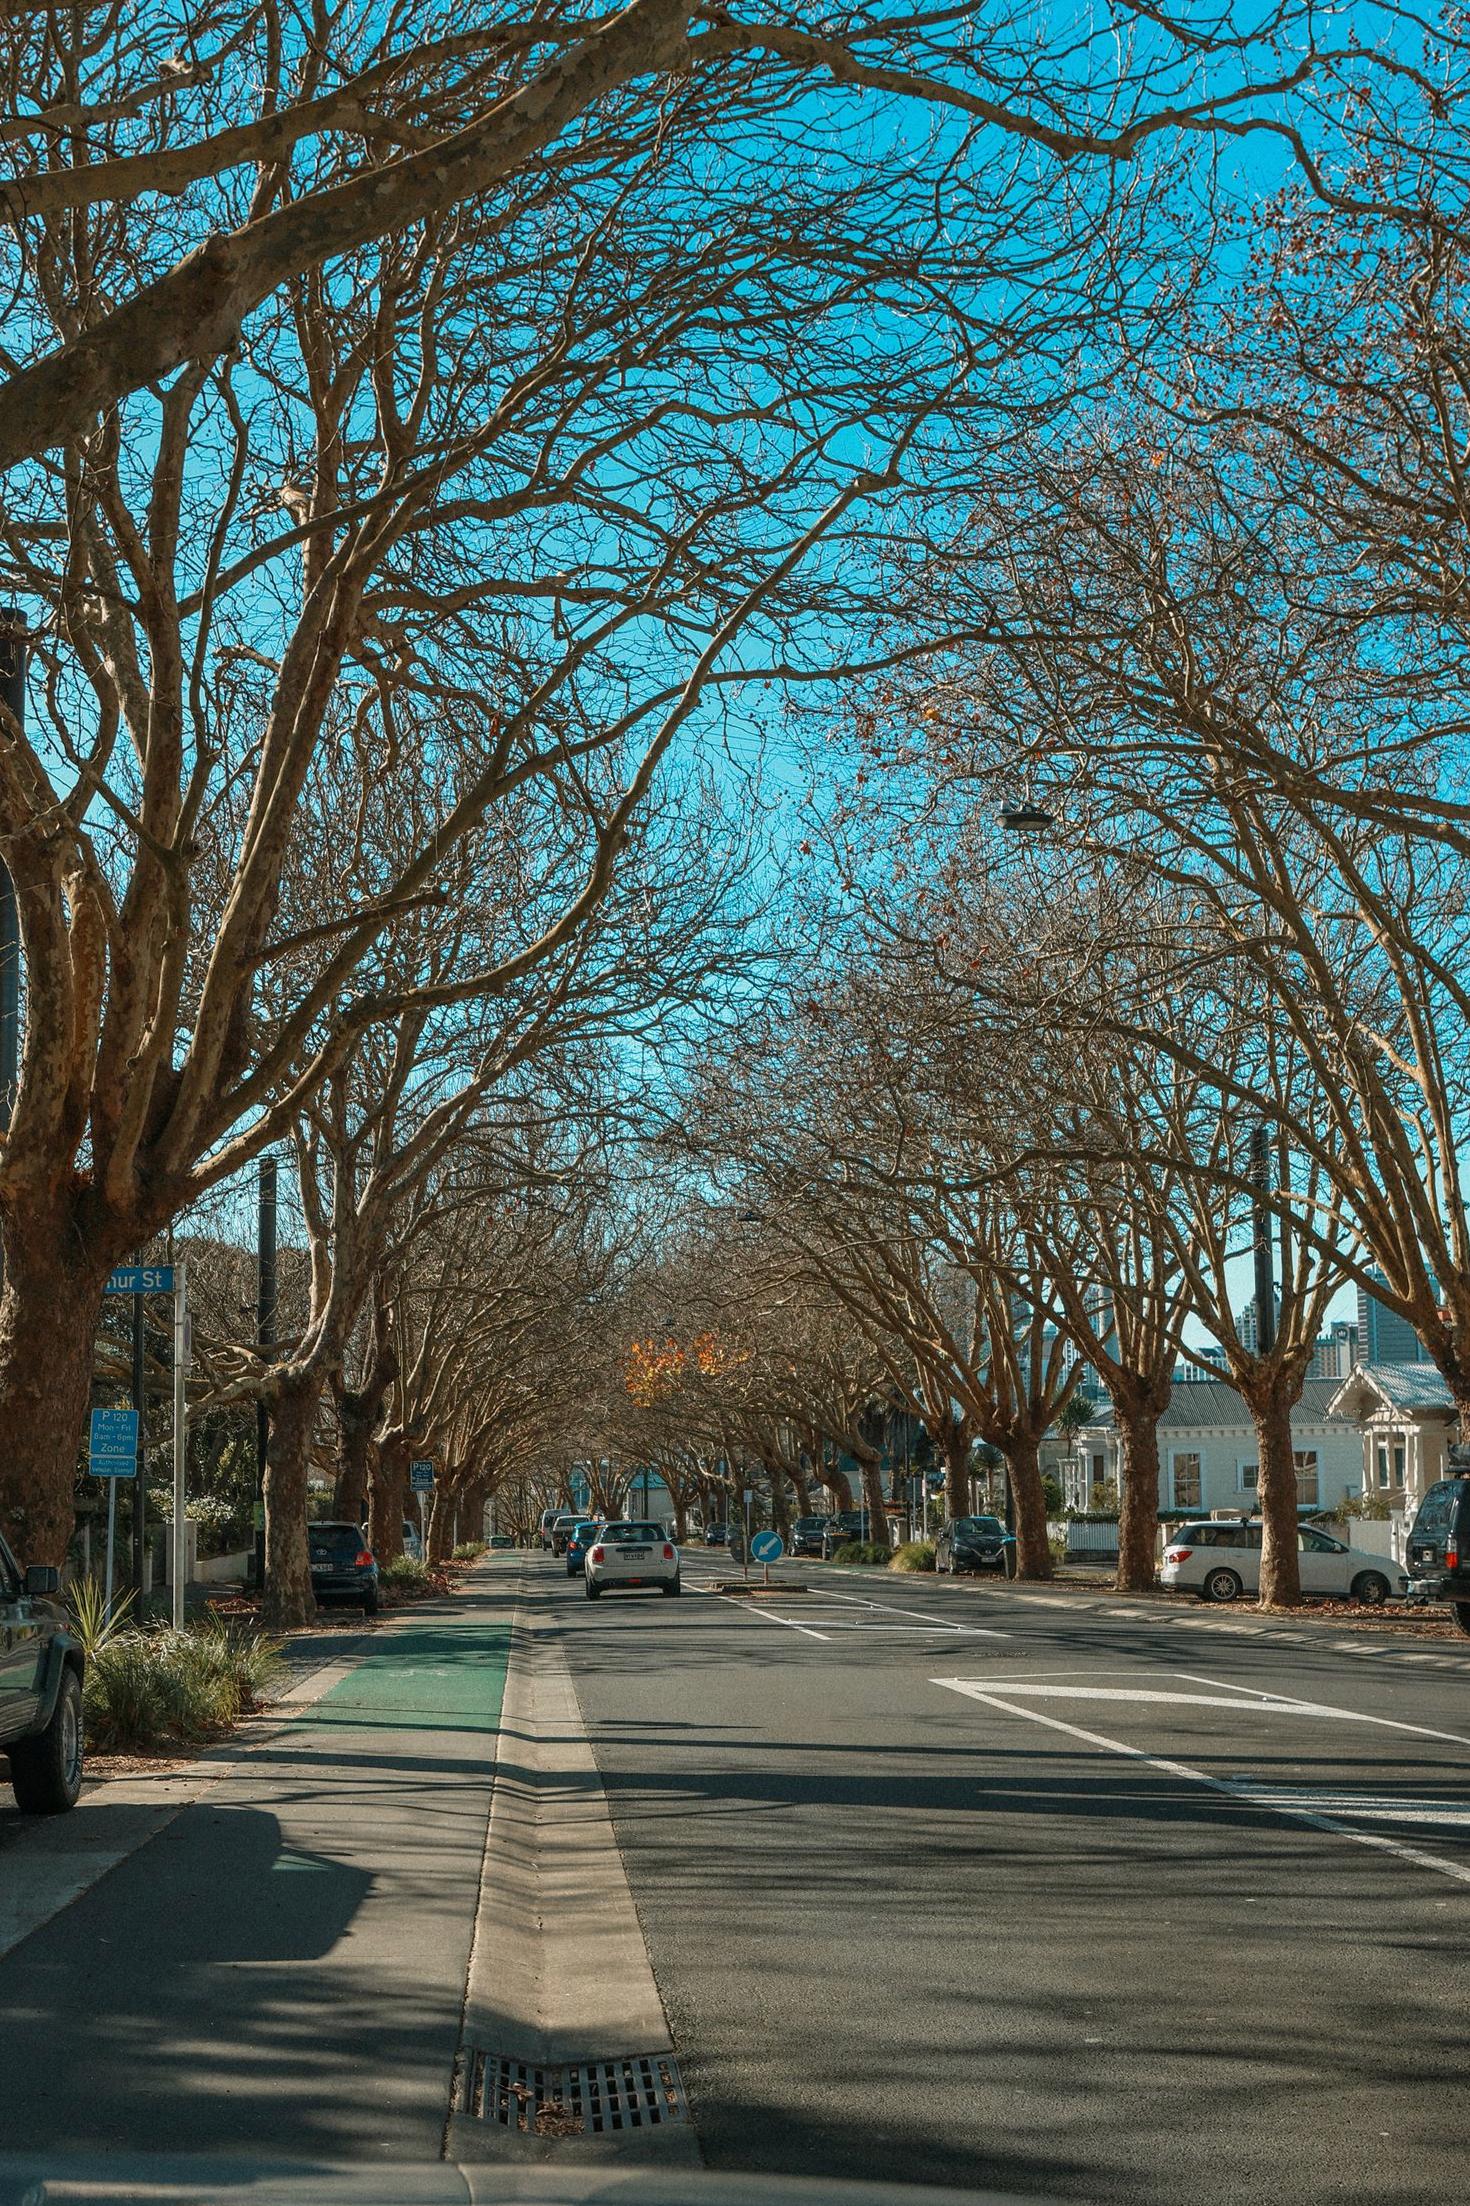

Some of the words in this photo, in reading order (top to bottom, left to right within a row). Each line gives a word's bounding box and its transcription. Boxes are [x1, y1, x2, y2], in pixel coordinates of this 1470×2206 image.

[142, 1271, 162, 1288] St
[102, 1410, 110, 1421] P
[112, 1412, 128, 1422] 120
[97, 1423, 114, 1431] Mon
[121, 1424, 131, 1432] Fri
[100, 1443, 125, 1453] Zone
